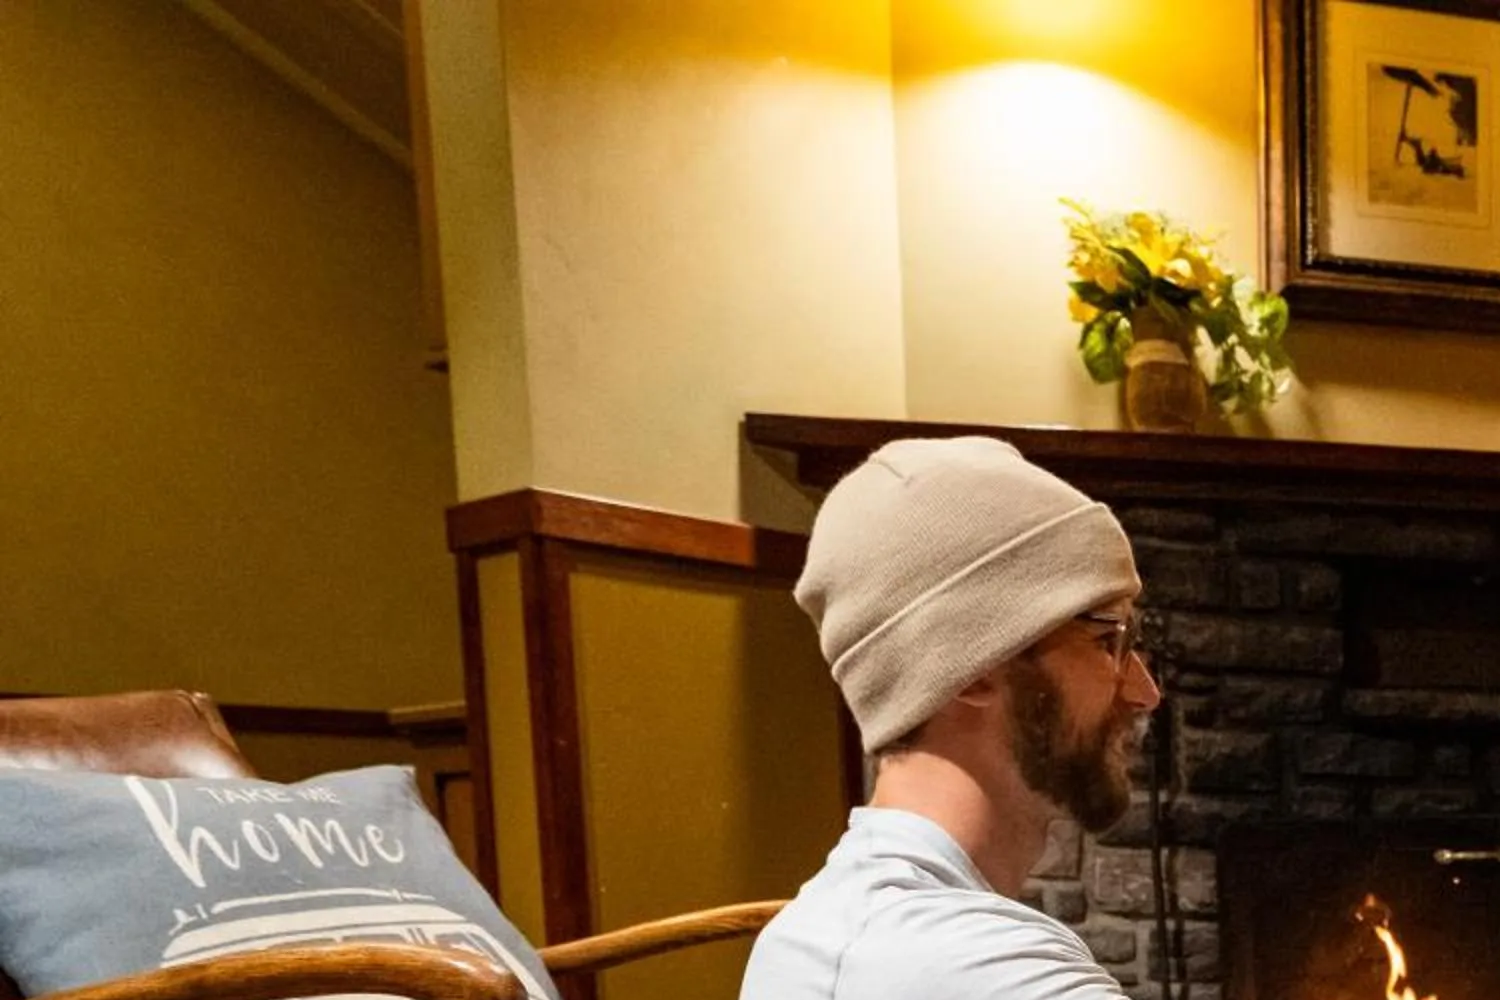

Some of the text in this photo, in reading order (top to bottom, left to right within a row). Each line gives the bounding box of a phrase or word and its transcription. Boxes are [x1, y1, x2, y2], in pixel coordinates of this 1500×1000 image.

[196, 785, 343, 805] TAKE ME
[124, 774, 405, 888] home
